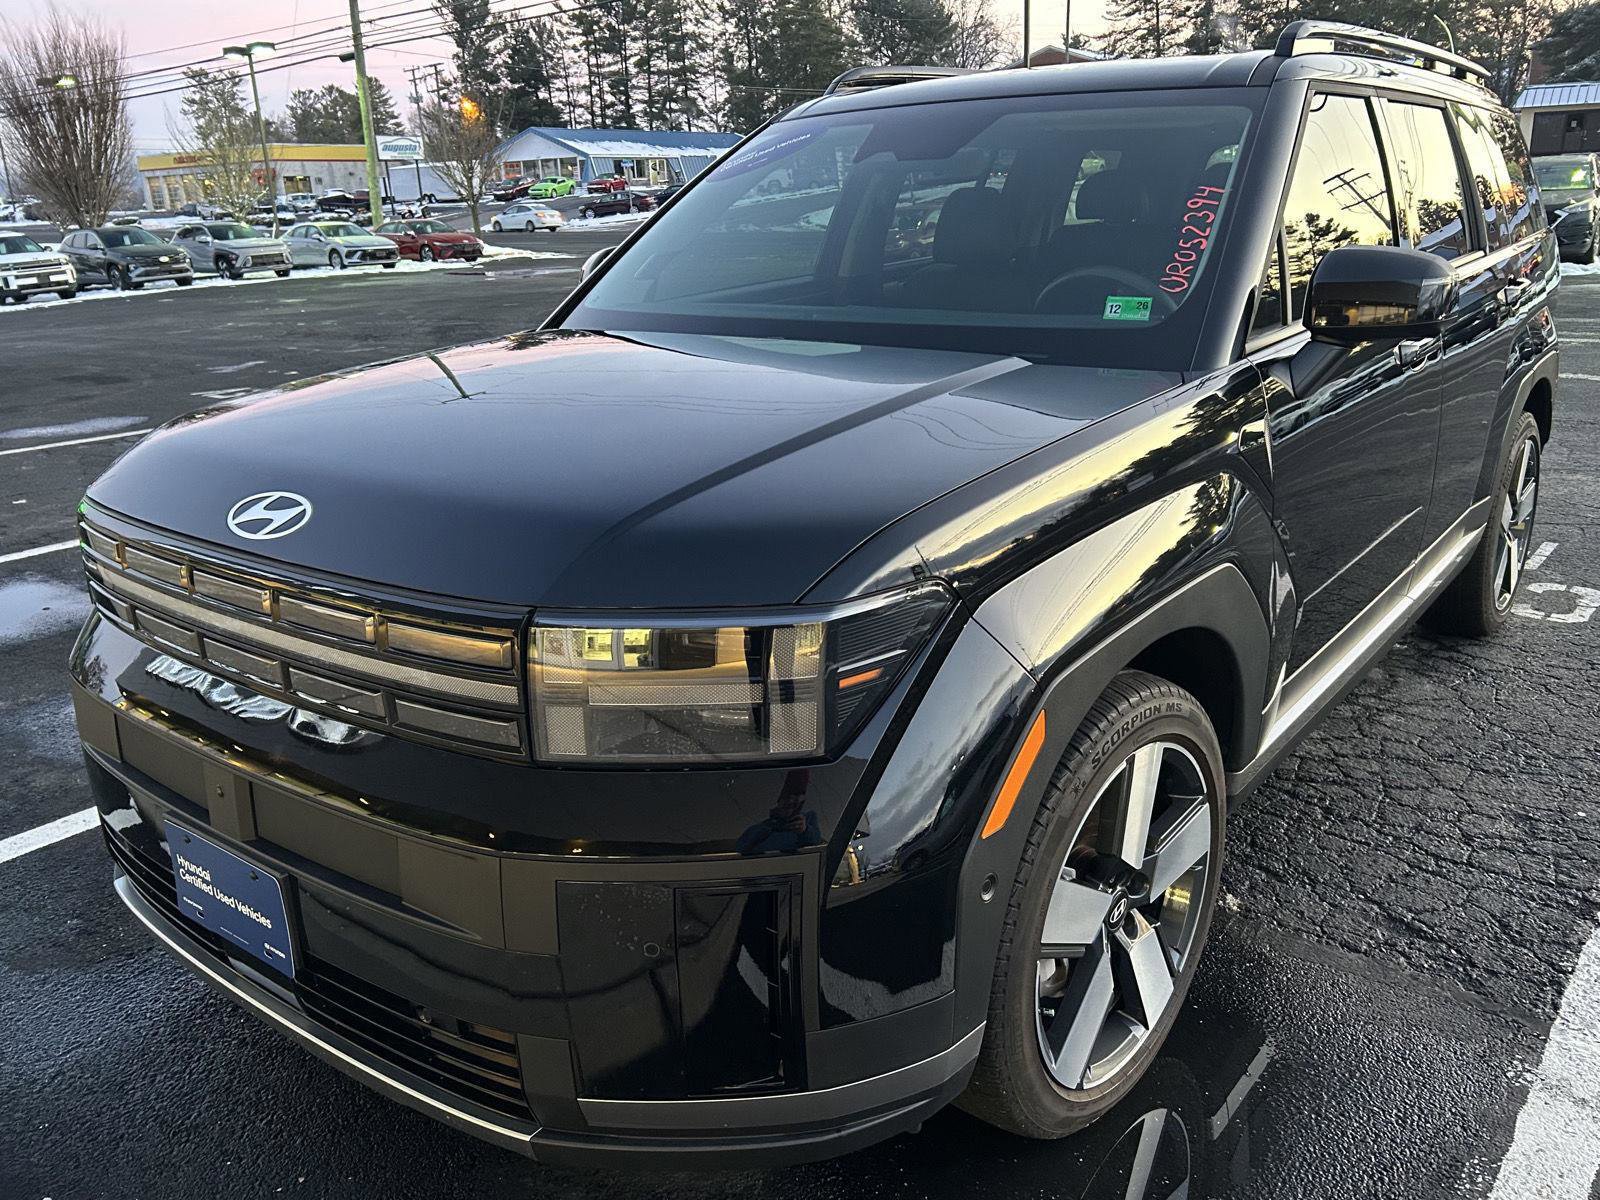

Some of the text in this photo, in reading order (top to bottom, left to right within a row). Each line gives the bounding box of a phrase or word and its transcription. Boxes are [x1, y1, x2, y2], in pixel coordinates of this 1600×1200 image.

[382, 143, 417, 152] augusta
[1108, 303, 1122, 315] 12
[1135, 301, 1149, 310] 26
[1091, 702, 1183, 770] SCORPION MS
[176, 854, 211, 881] Hyundai
[179, 868, 213, 896] Certified
[213, 886, 236, 908] Used
[235, 899, 272, 929] Vehicles
